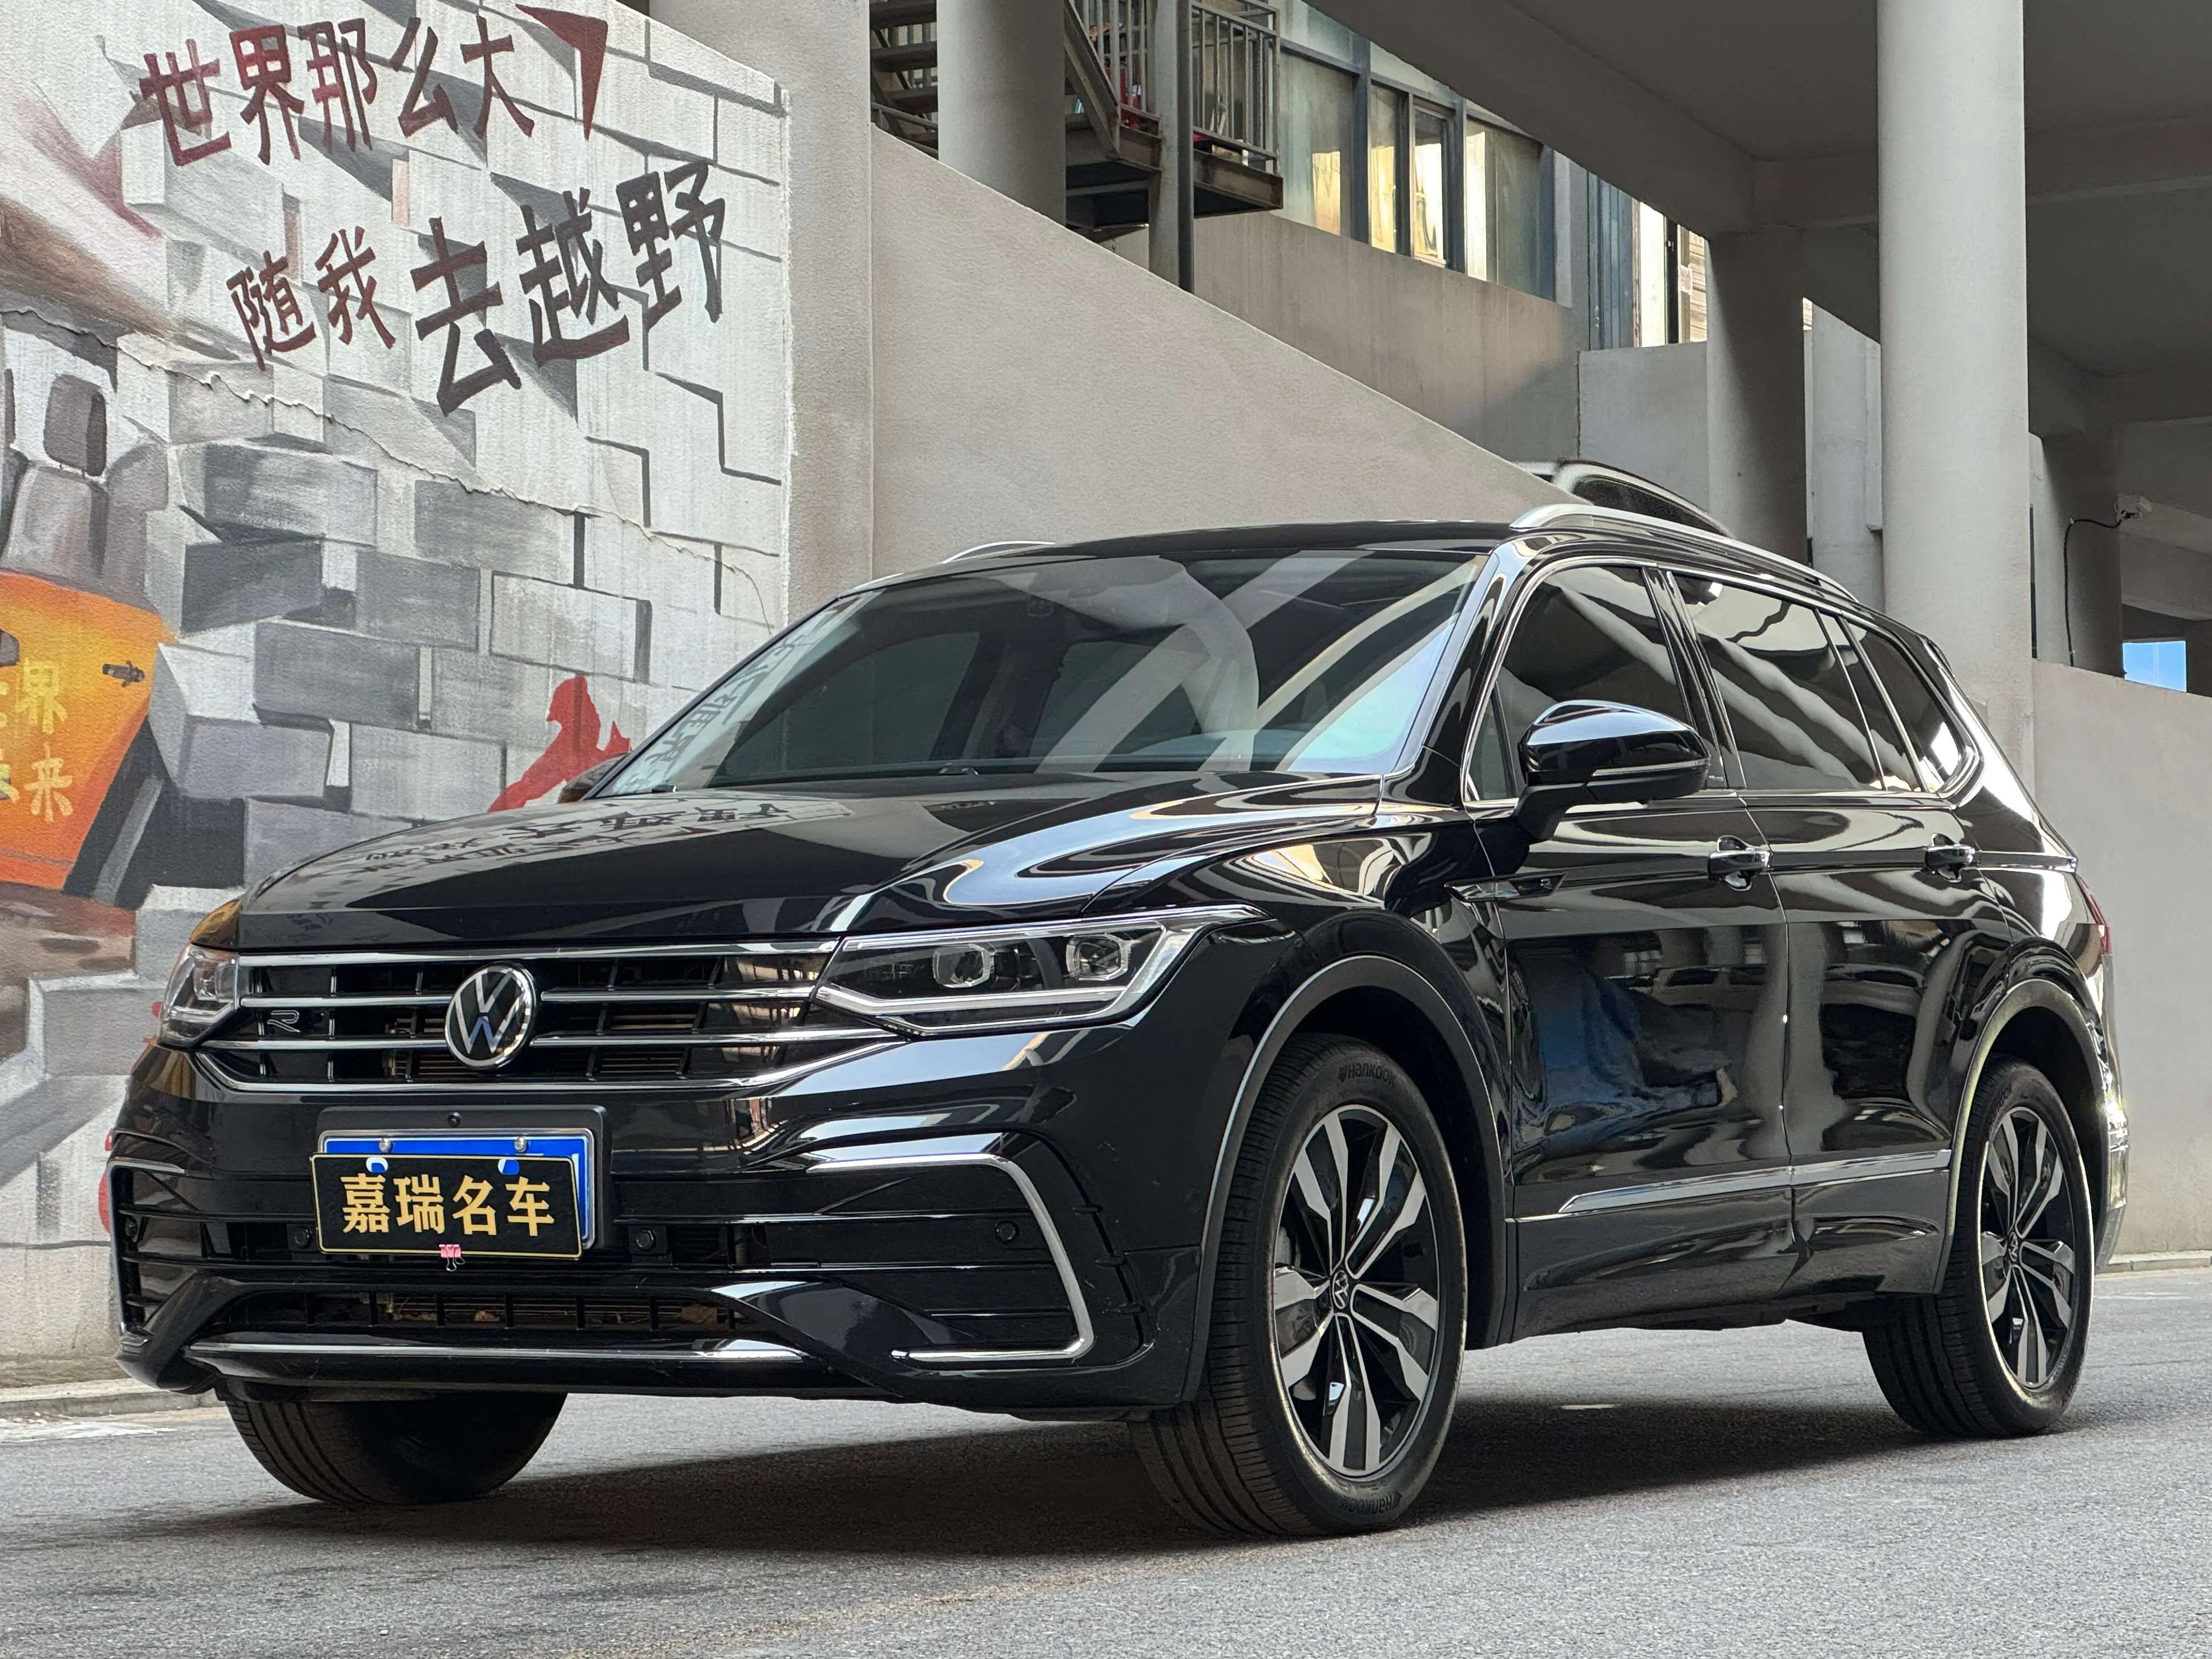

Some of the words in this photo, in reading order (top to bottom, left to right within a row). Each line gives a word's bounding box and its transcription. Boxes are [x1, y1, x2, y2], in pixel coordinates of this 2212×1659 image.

[139, 15, 535, 166] 世界那么大
[226, 161, 725, 416] 随我去越野
[0, 658, 68, 735] 界
[267, 1009, 301, 1032] R
[452, 967, 527, 1056] VW
[340, 1172, 555, 1237] 嘉瑞名车
